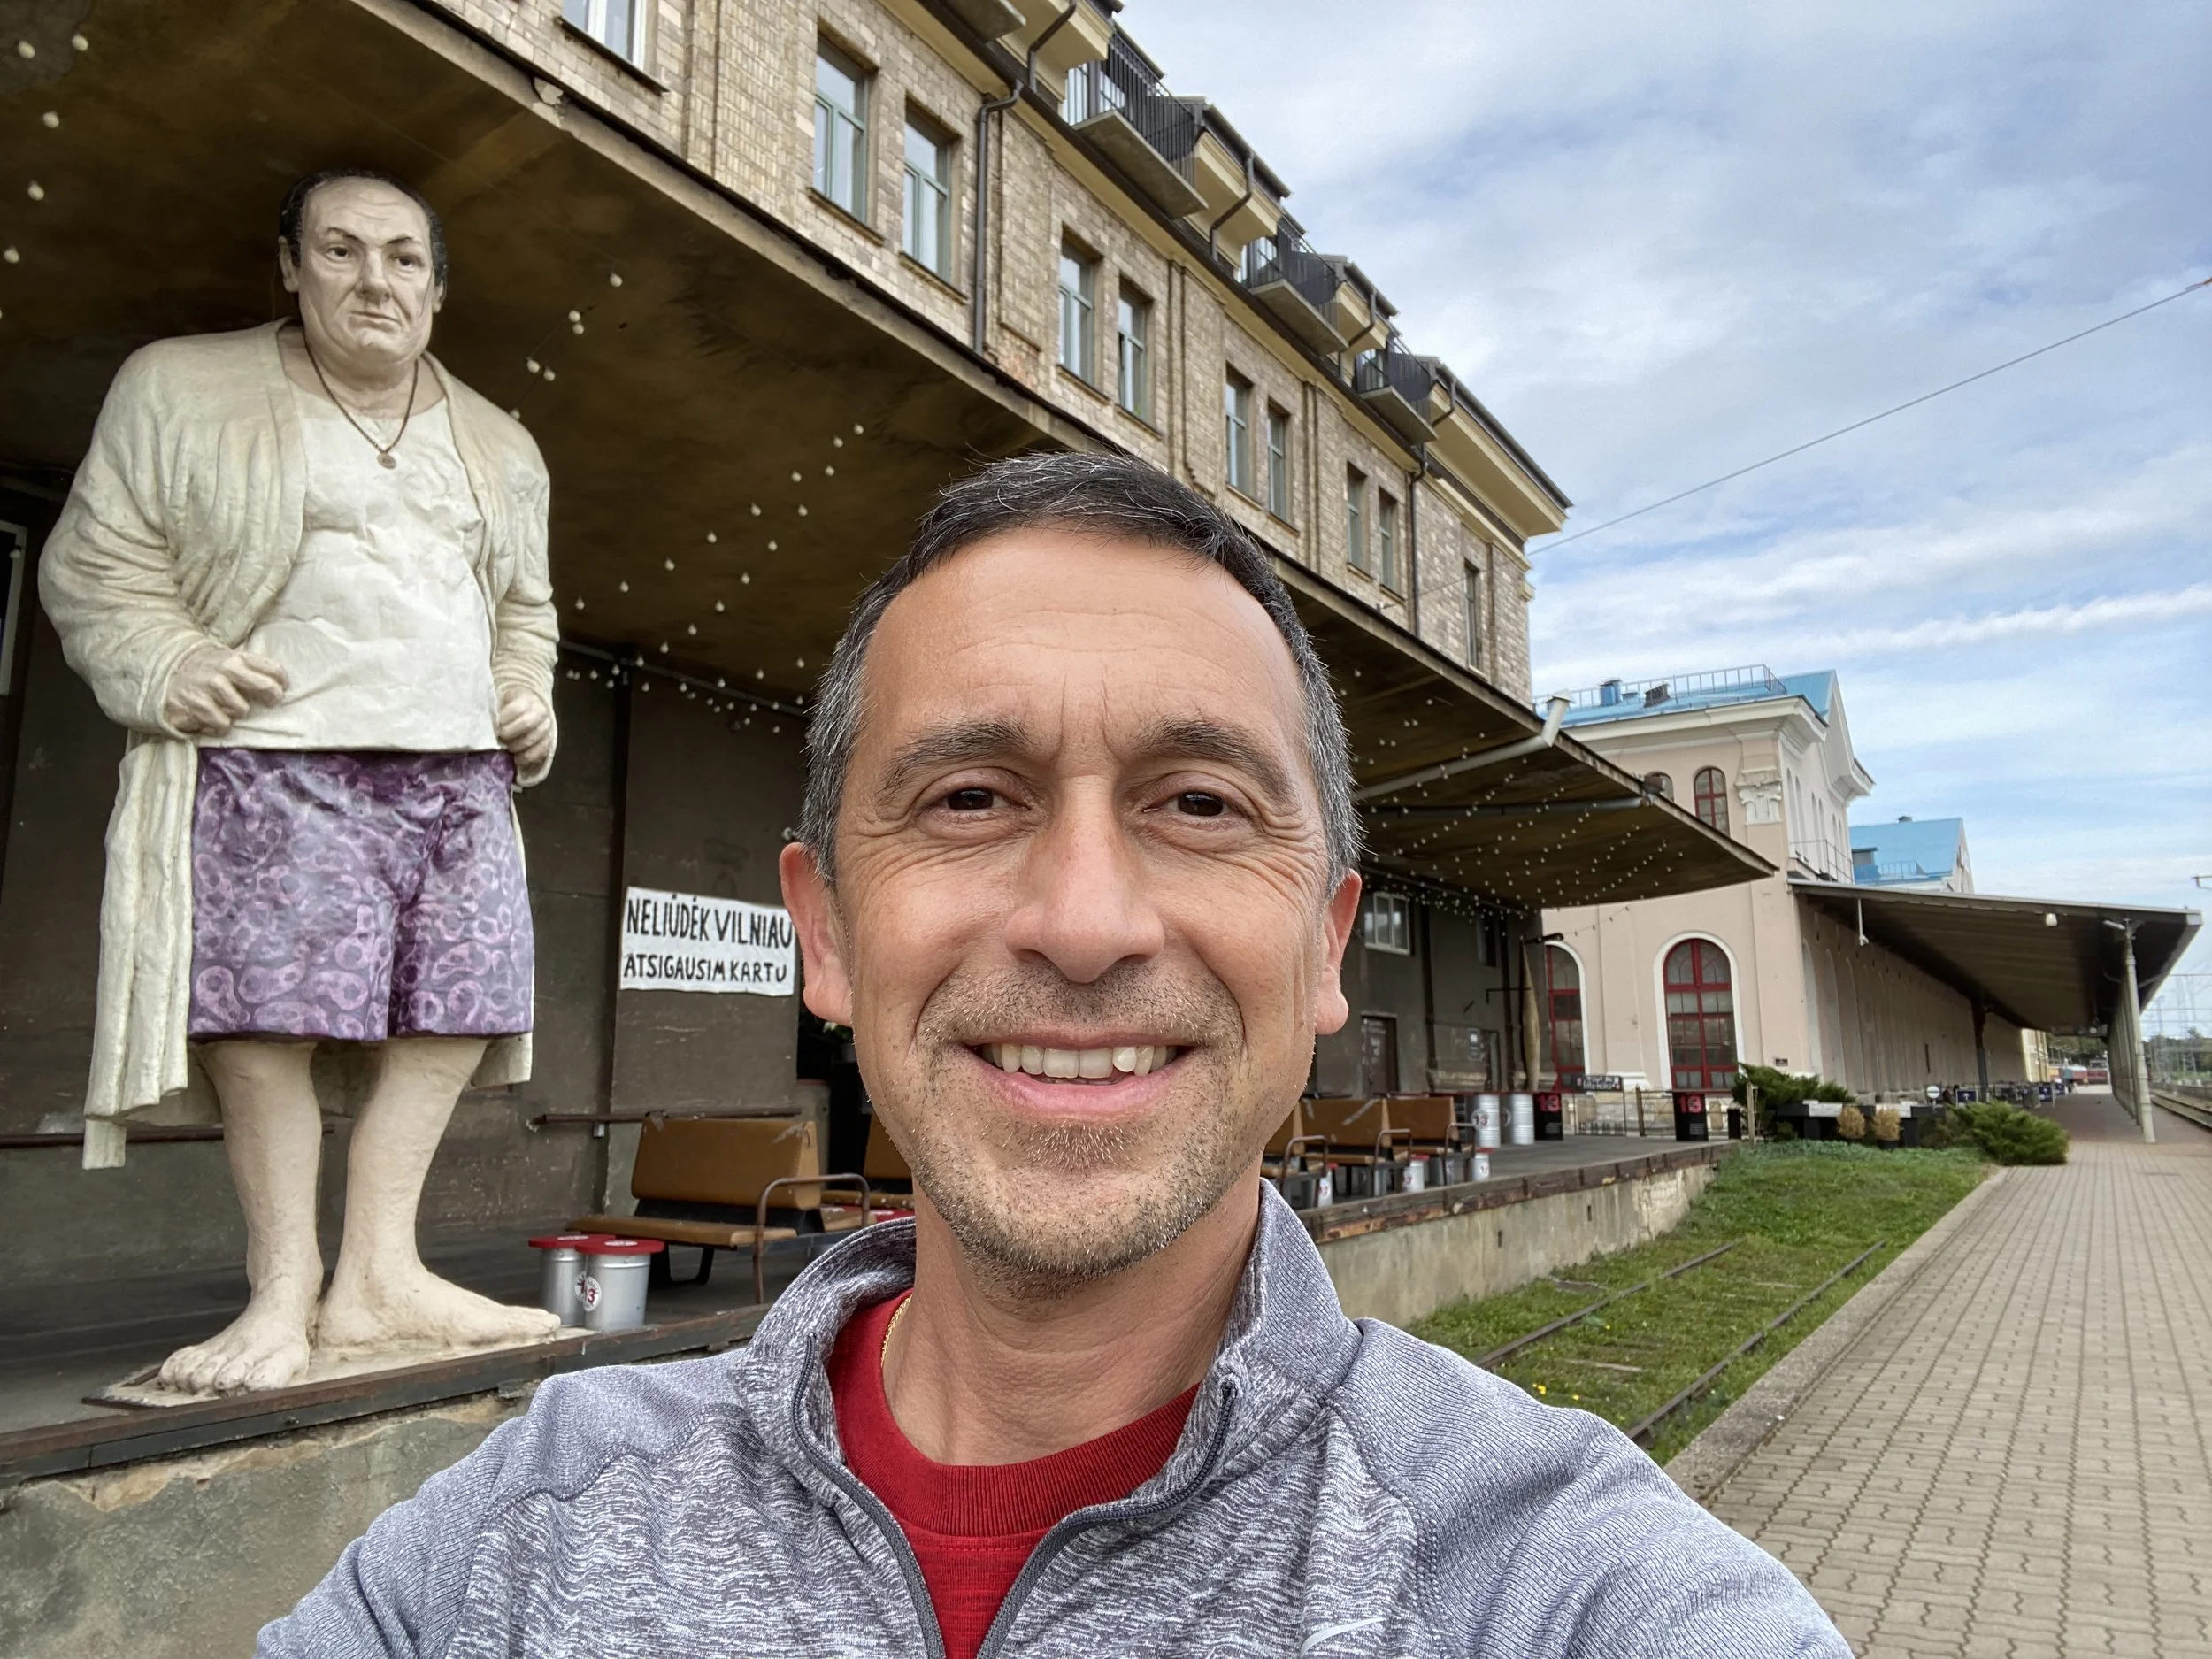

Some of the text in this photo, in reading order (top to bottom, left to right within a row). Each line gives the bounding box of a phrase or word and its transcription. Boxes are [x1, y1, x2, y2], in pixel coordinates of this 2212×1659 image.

[715, 909, 792, 949] VILNIAU
[624, 953, 787, 983] ATSIGAUSIM KARTU
